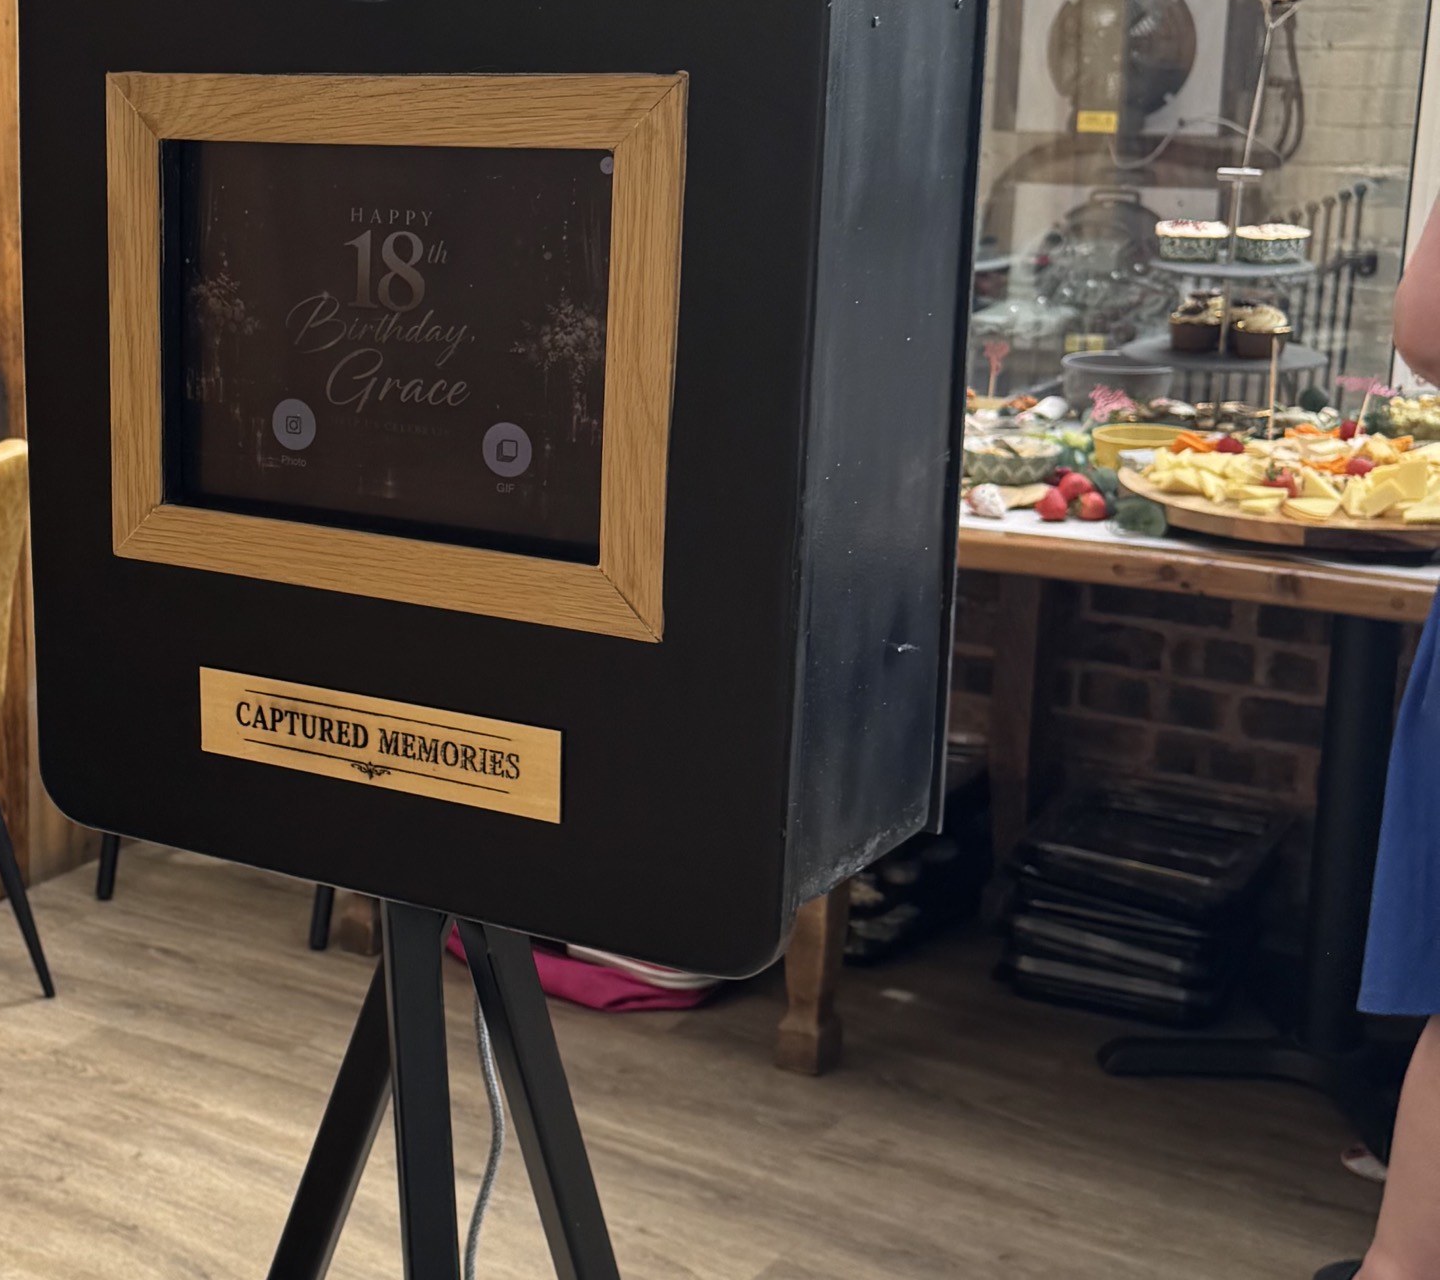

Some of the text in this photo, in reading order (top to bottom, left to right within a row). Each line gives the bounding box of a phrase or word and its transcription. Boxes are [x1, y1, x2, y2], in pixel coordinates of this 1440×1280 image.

[350, 207, 433, 227] HAPPY
[325, 347, 471, 413] Grace
[280, 454, 307, 468] Photo
[496, 482, 516, 494] GIF
[236, 701, 520, 780] CAPTURED MEMORIES
